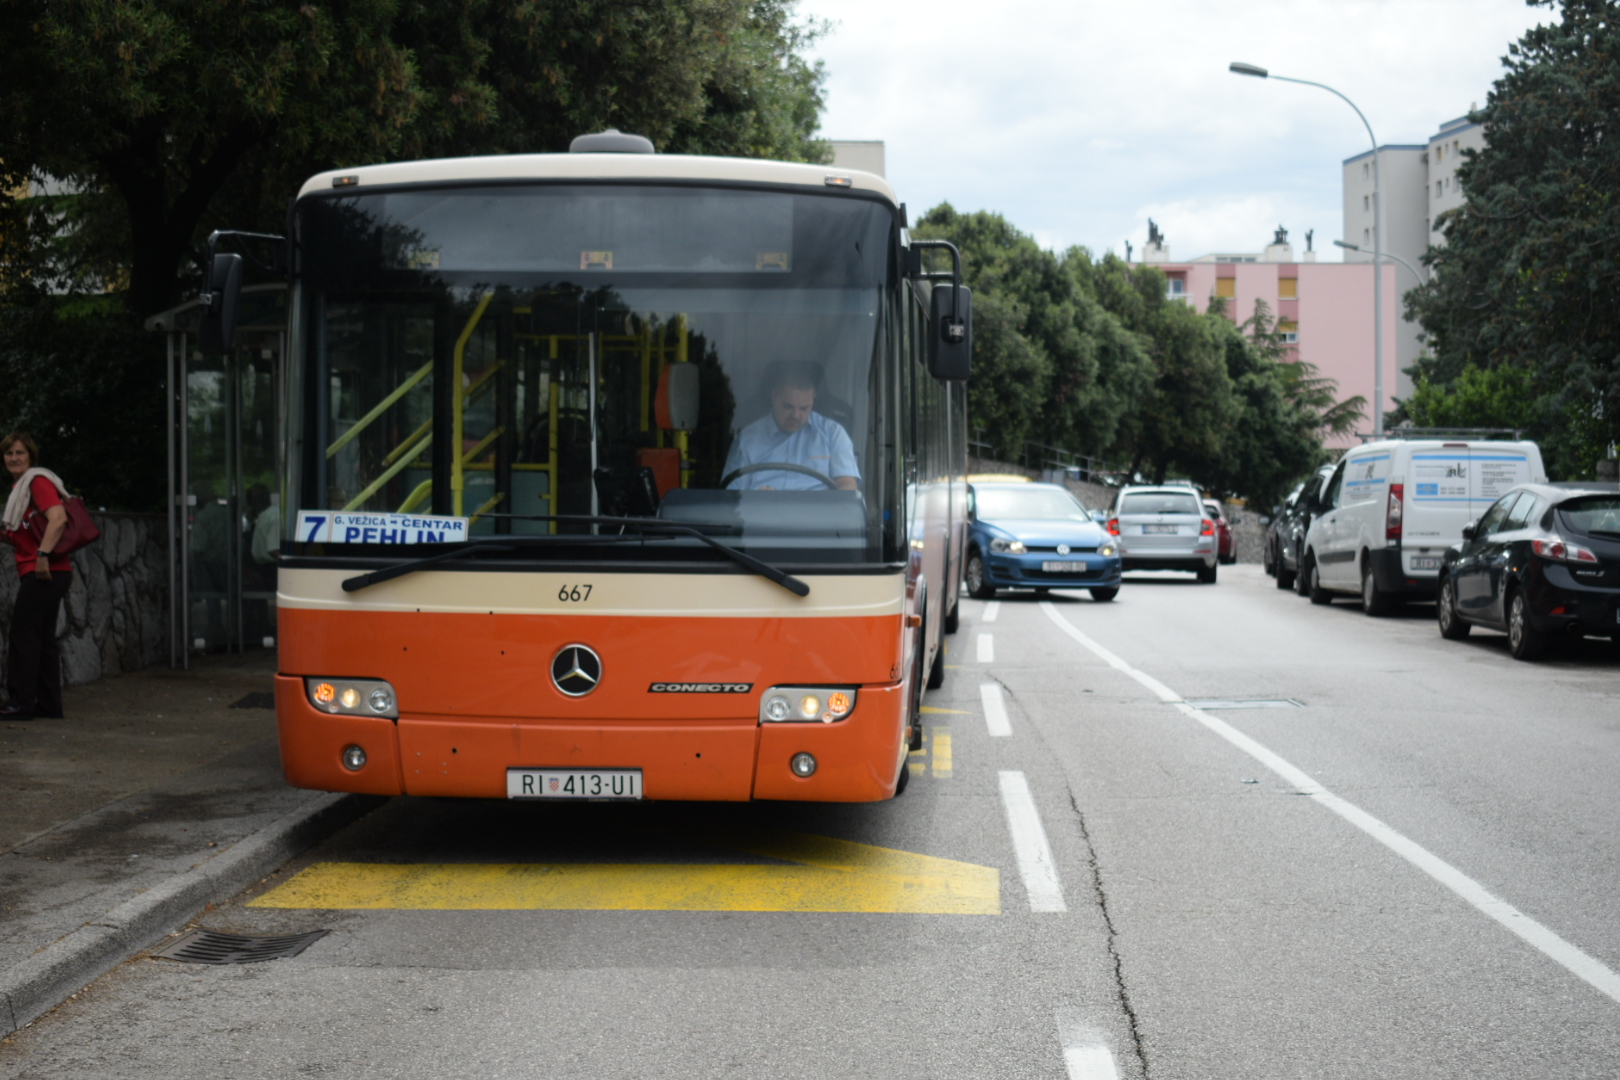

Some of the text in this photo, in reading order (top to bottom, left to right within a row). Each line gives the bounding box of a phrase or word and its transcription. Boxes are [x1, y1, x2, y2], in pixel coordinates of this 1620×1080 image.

[304, 516, 326, 543] 7
[334, 515, 345, 525] G.
[349, 515, 387, 527] VEŽICA
[401, 518, 463, 531] CENTAR
[558, 584, 593, 602] 667
[651, 683, 750, 693] CONECTO
[522, 774, 634, 795] RI 413-UI
